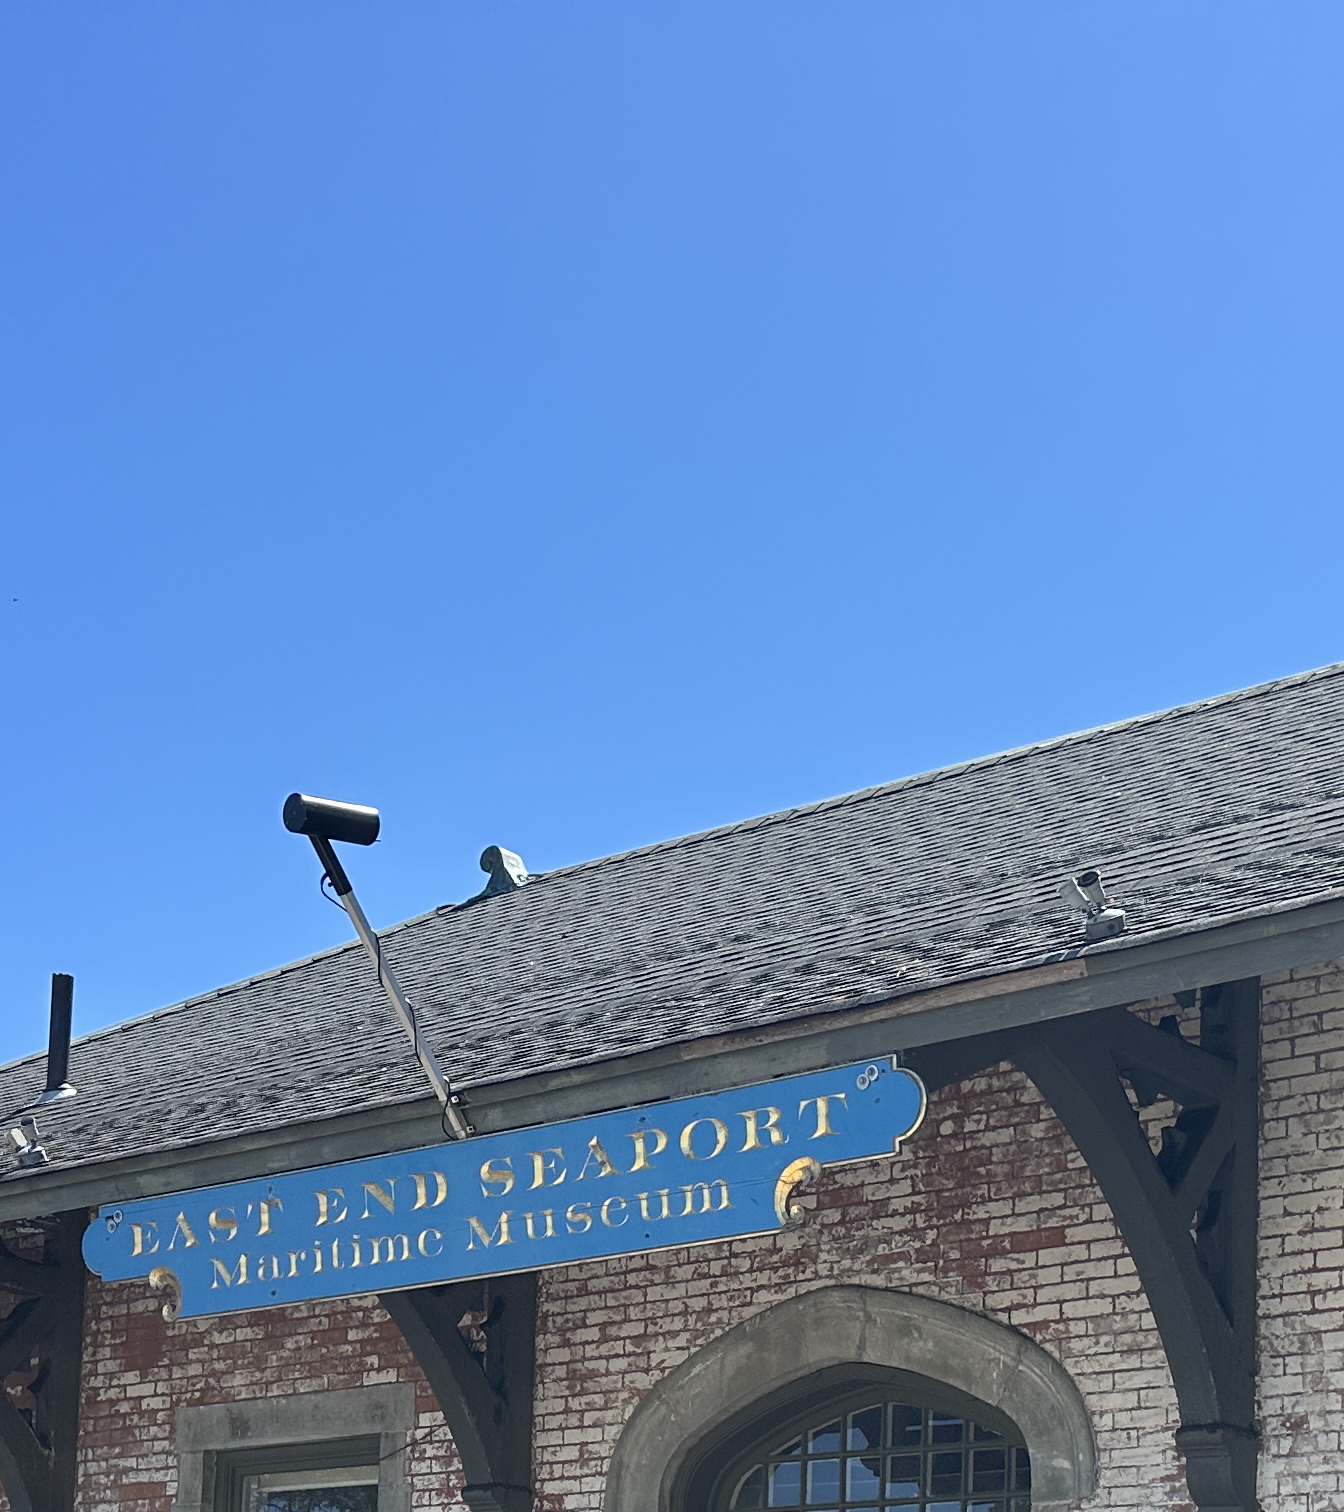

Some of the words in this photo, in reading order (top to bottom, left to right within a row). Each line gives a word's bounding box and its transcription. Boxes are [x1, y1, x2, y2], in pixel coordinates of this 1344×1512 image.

[130, 1198, 284, 1258] EAST
[314, 1171, 449, 1228] END
[479, 1093, 849, 1199] SEAPORT
[210, 1226, 444, 1291] Maritime
[465, 1178, 734, 1251] Museum
